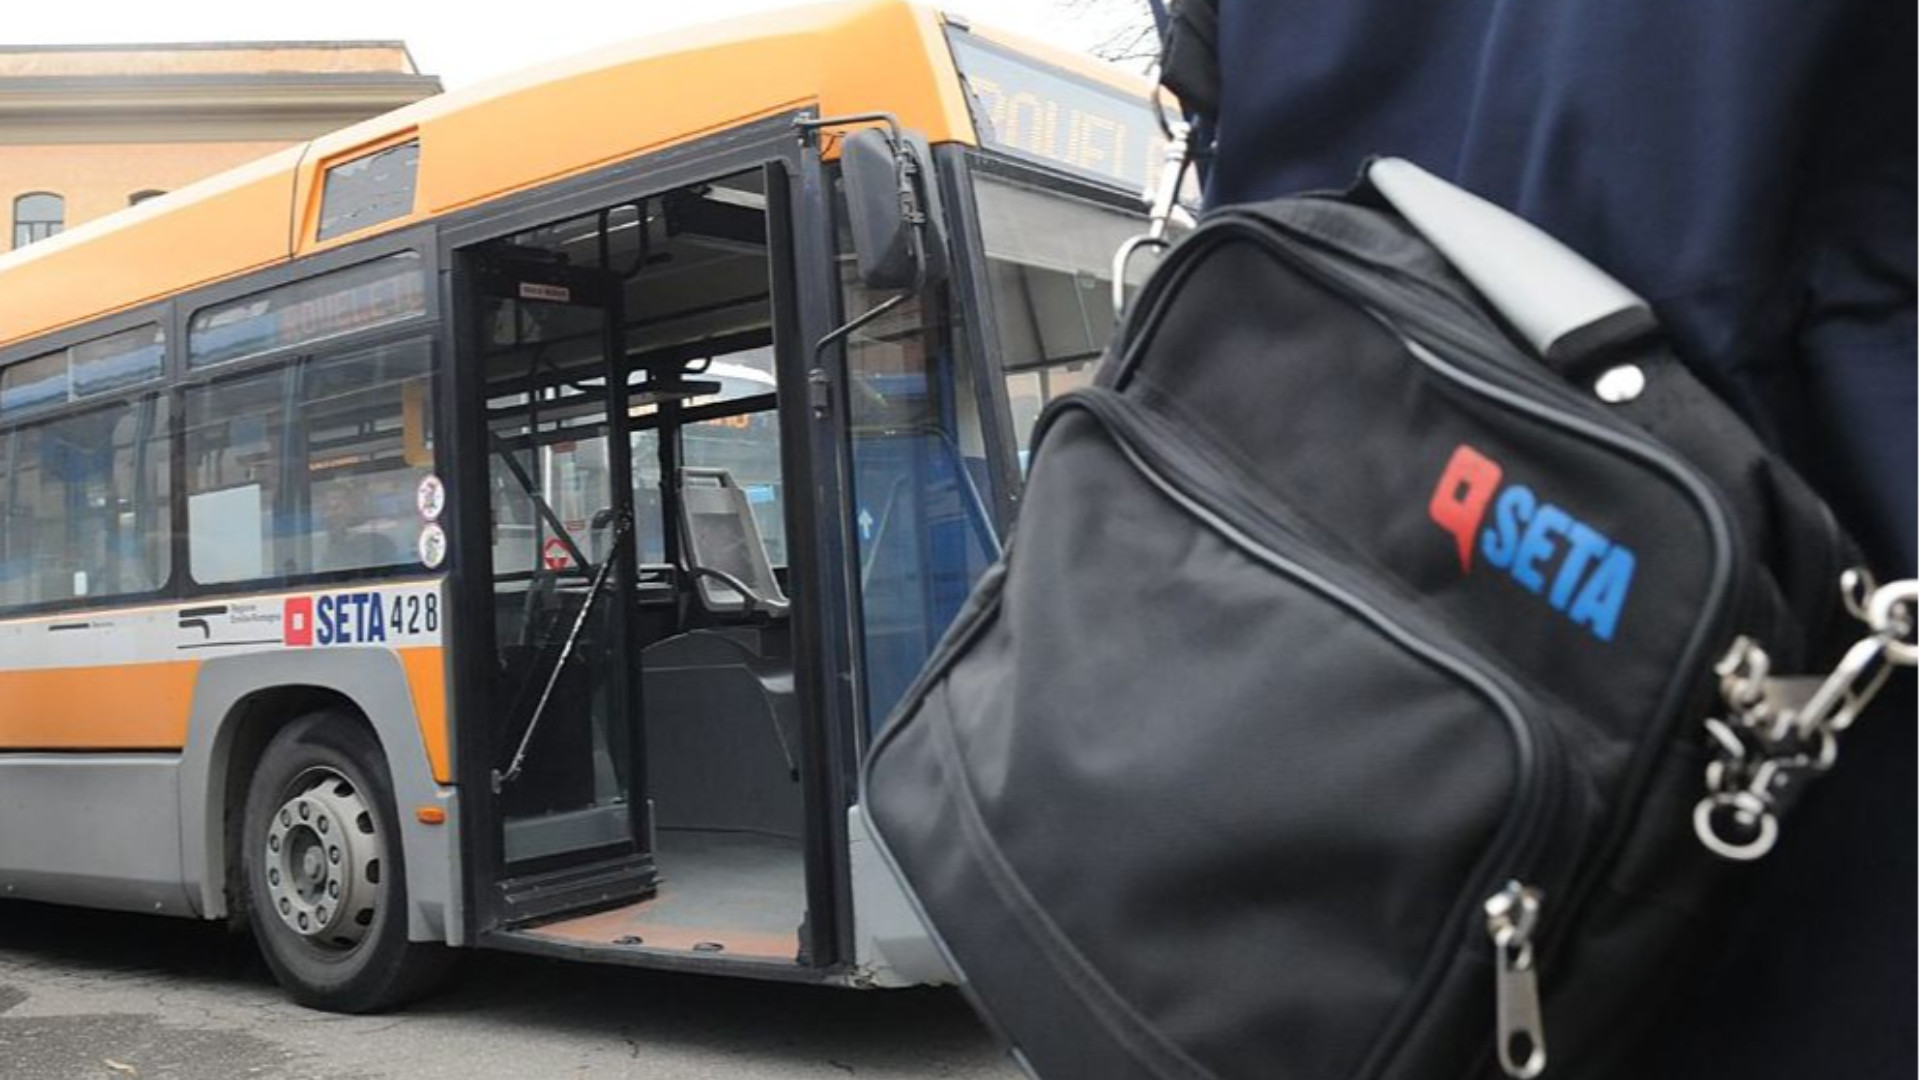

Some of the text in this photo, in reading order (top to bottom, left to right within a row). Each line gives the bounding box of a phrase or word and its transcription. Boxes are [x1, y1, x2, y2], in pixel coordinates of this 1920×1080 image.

[1482, 485, 1636, 642] SETA
[317, 592, 438, 645] SETA 428
